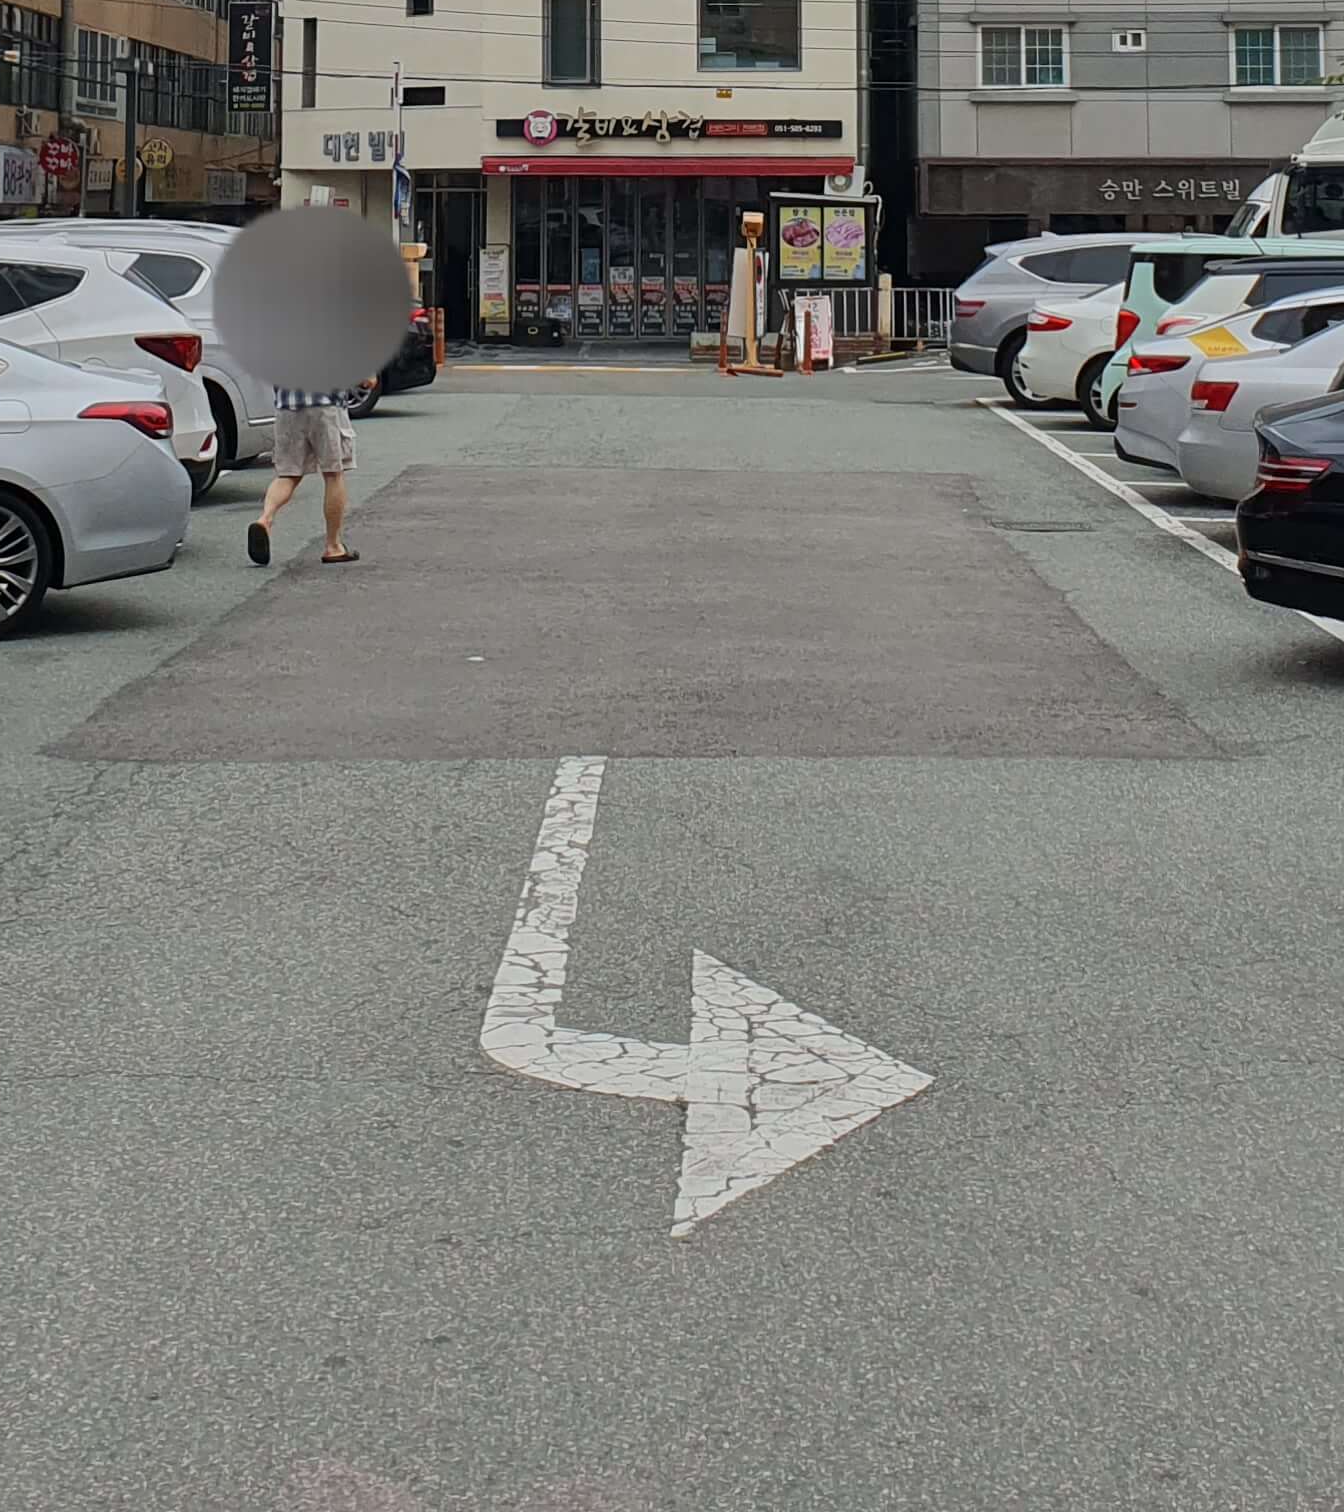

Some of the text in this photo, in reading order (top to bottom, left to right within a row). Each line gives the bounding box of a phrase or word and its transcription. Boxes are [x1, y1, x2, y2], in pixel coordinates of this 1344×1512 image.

[323, 131, 360, 162] 대현
[1099, 179, 1242, 201] 승만 스위트빌
